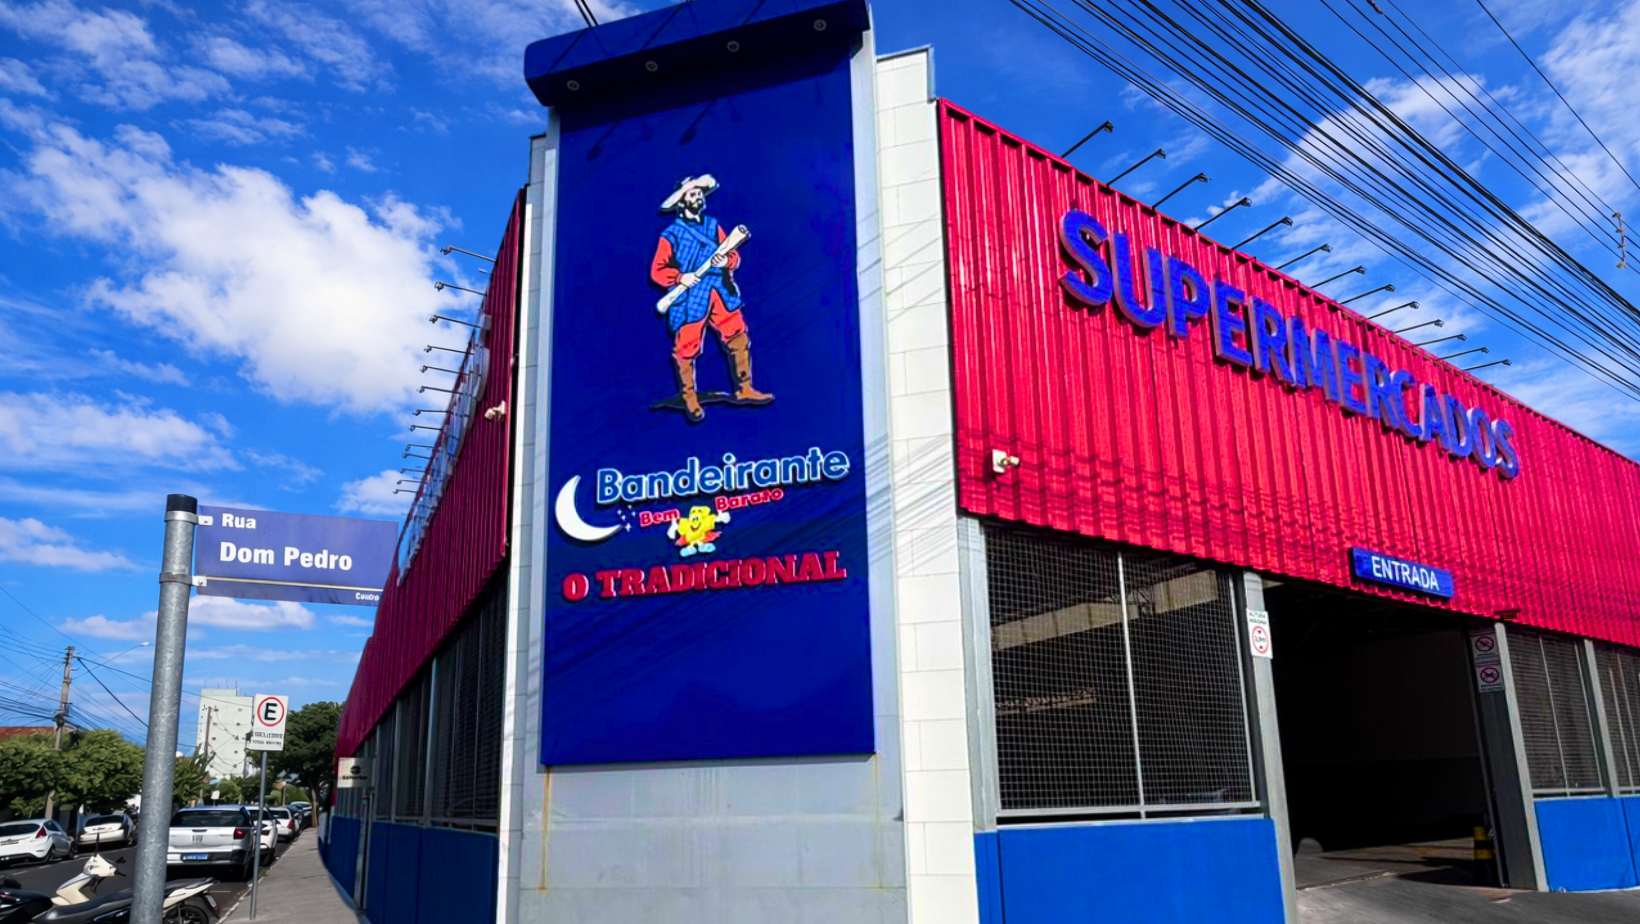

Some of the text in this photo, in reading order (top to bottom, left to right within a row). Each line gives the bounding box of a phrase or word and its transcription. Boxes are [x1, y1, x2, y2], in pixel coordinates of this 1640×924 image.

[1060, 208, 1519, 480] SUPERMERCADOS
[597, 447, 850, 504] Bandeirante
[221, 513, 257, 530] Rua
[639, 488, 783, 527] Bem Barato
[220, 541, 353, 571] Dom Pedro
[1371, 555, 1440, 591] ENTRADA
[563, 551, 847, 600] O TRADICIONAL
[264, 702, 278, 721] E
